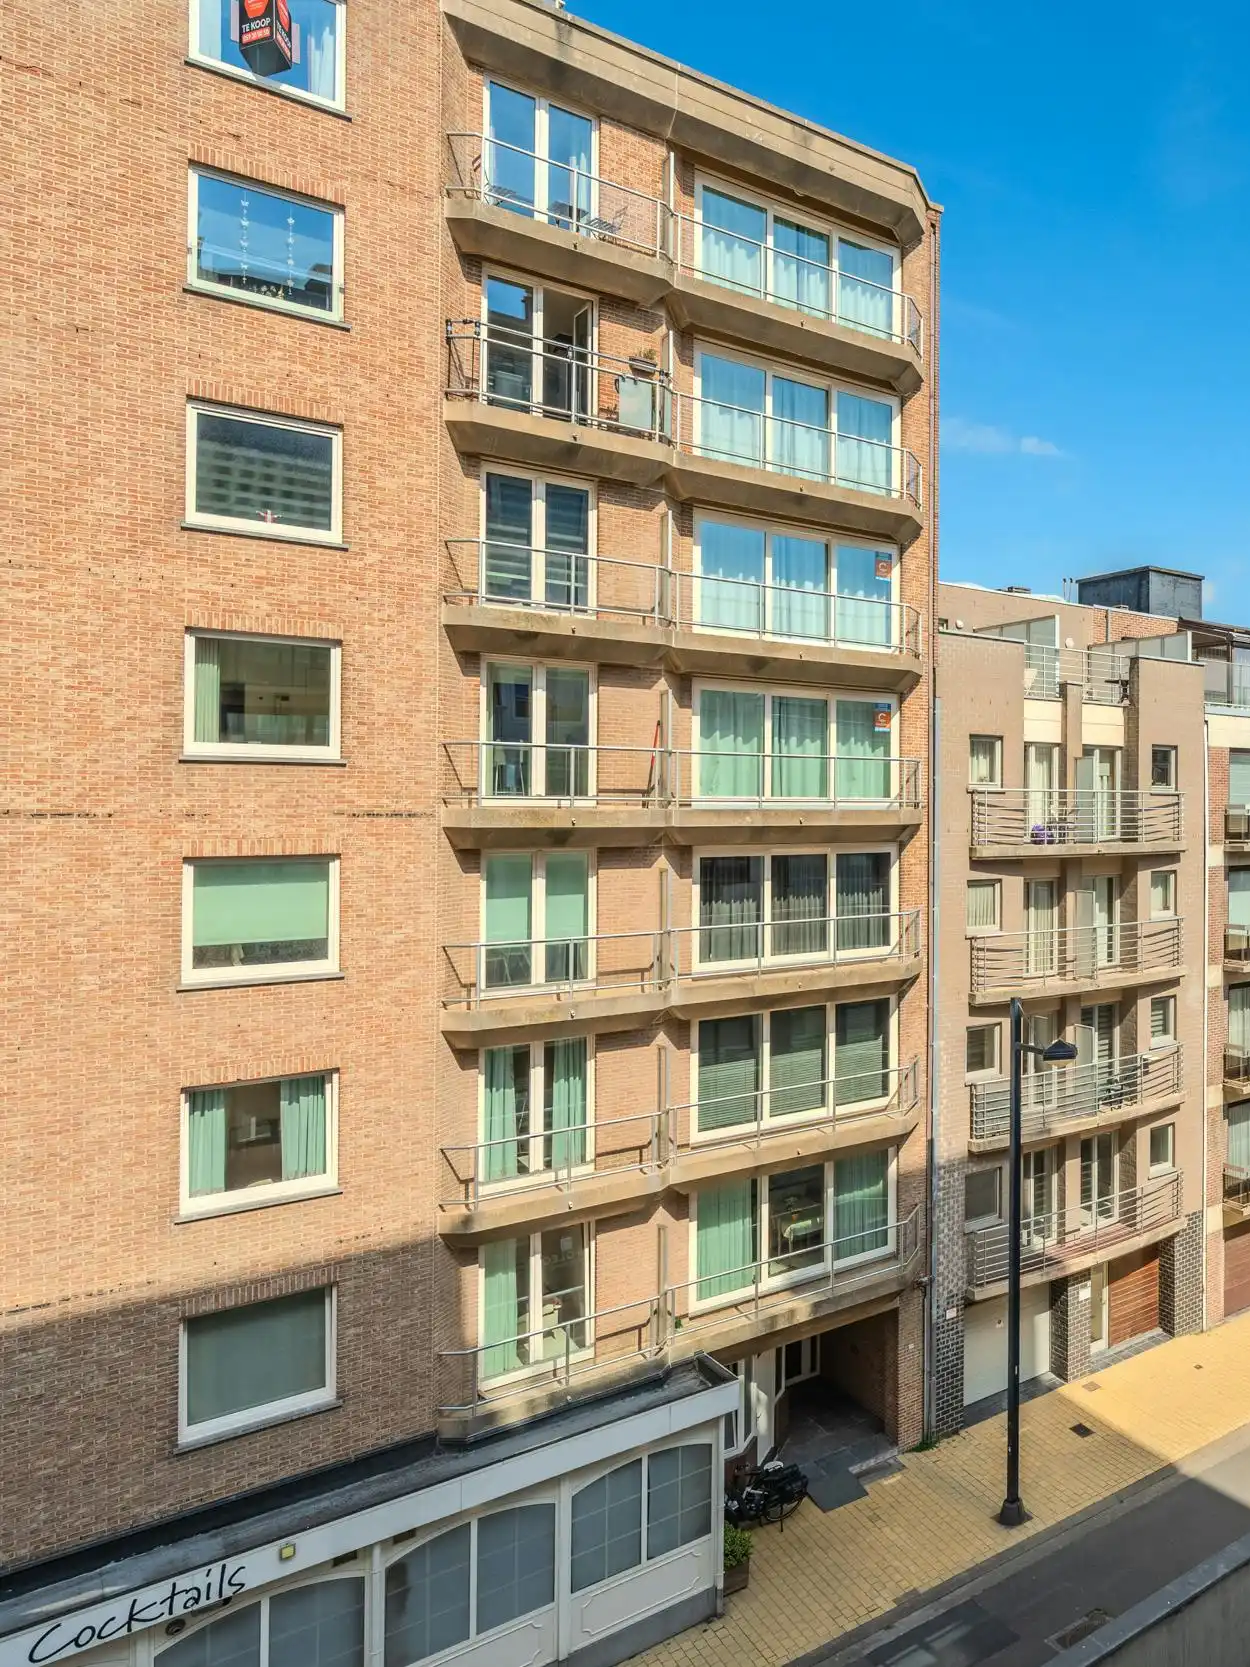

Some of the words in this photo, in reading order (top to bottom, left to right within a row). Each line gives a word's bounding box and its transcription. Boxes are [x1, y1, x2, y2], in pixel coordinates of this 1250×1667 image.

[242, 23, 250, 33] TE
[251, 17, 271, 30] KOOP
[28, 1563, 246, 1664] Cocktails
